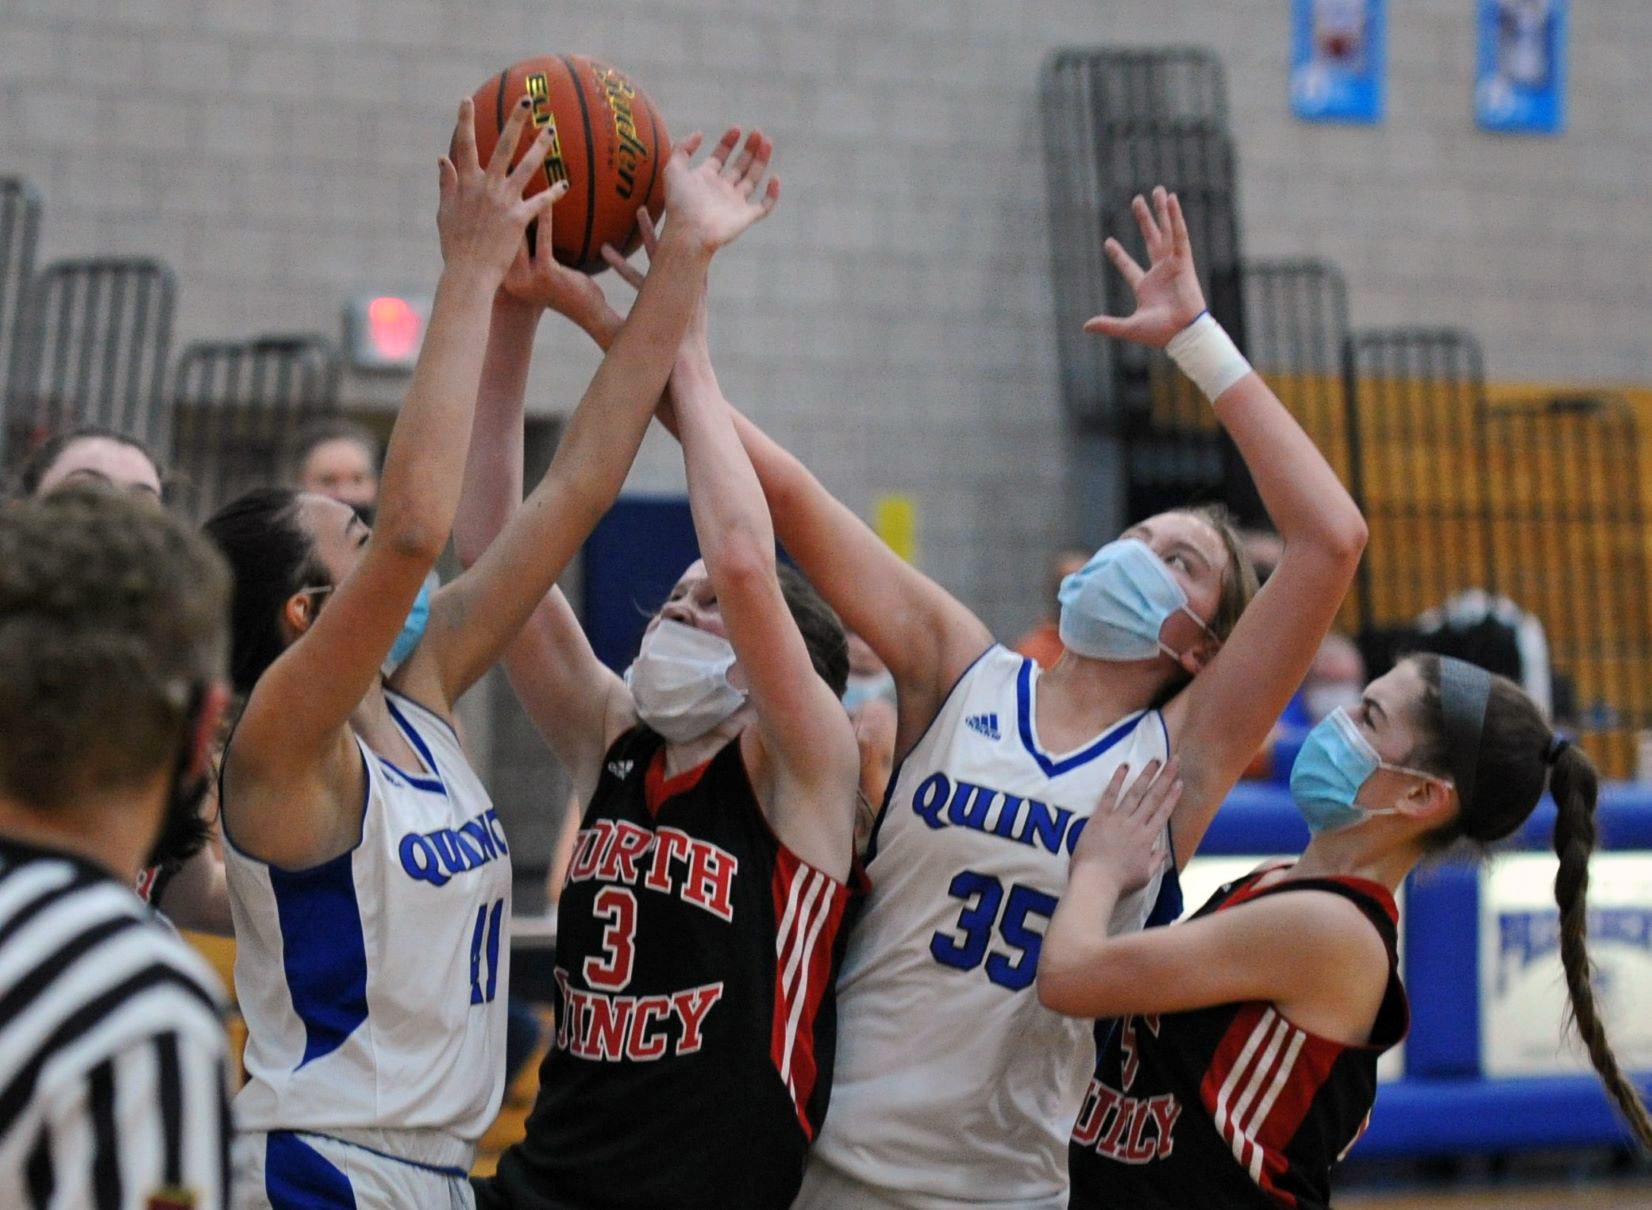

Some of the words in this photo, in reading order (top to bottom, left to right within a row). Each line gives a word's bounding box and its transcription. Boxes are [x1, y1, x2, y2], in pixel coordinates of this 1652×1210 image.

[469, 898, 504, 1006] 11
[582, 885, 638, 992] 3
[929, 869, 1060, 992] 35
[553, 966, 725, 1063] INCY
